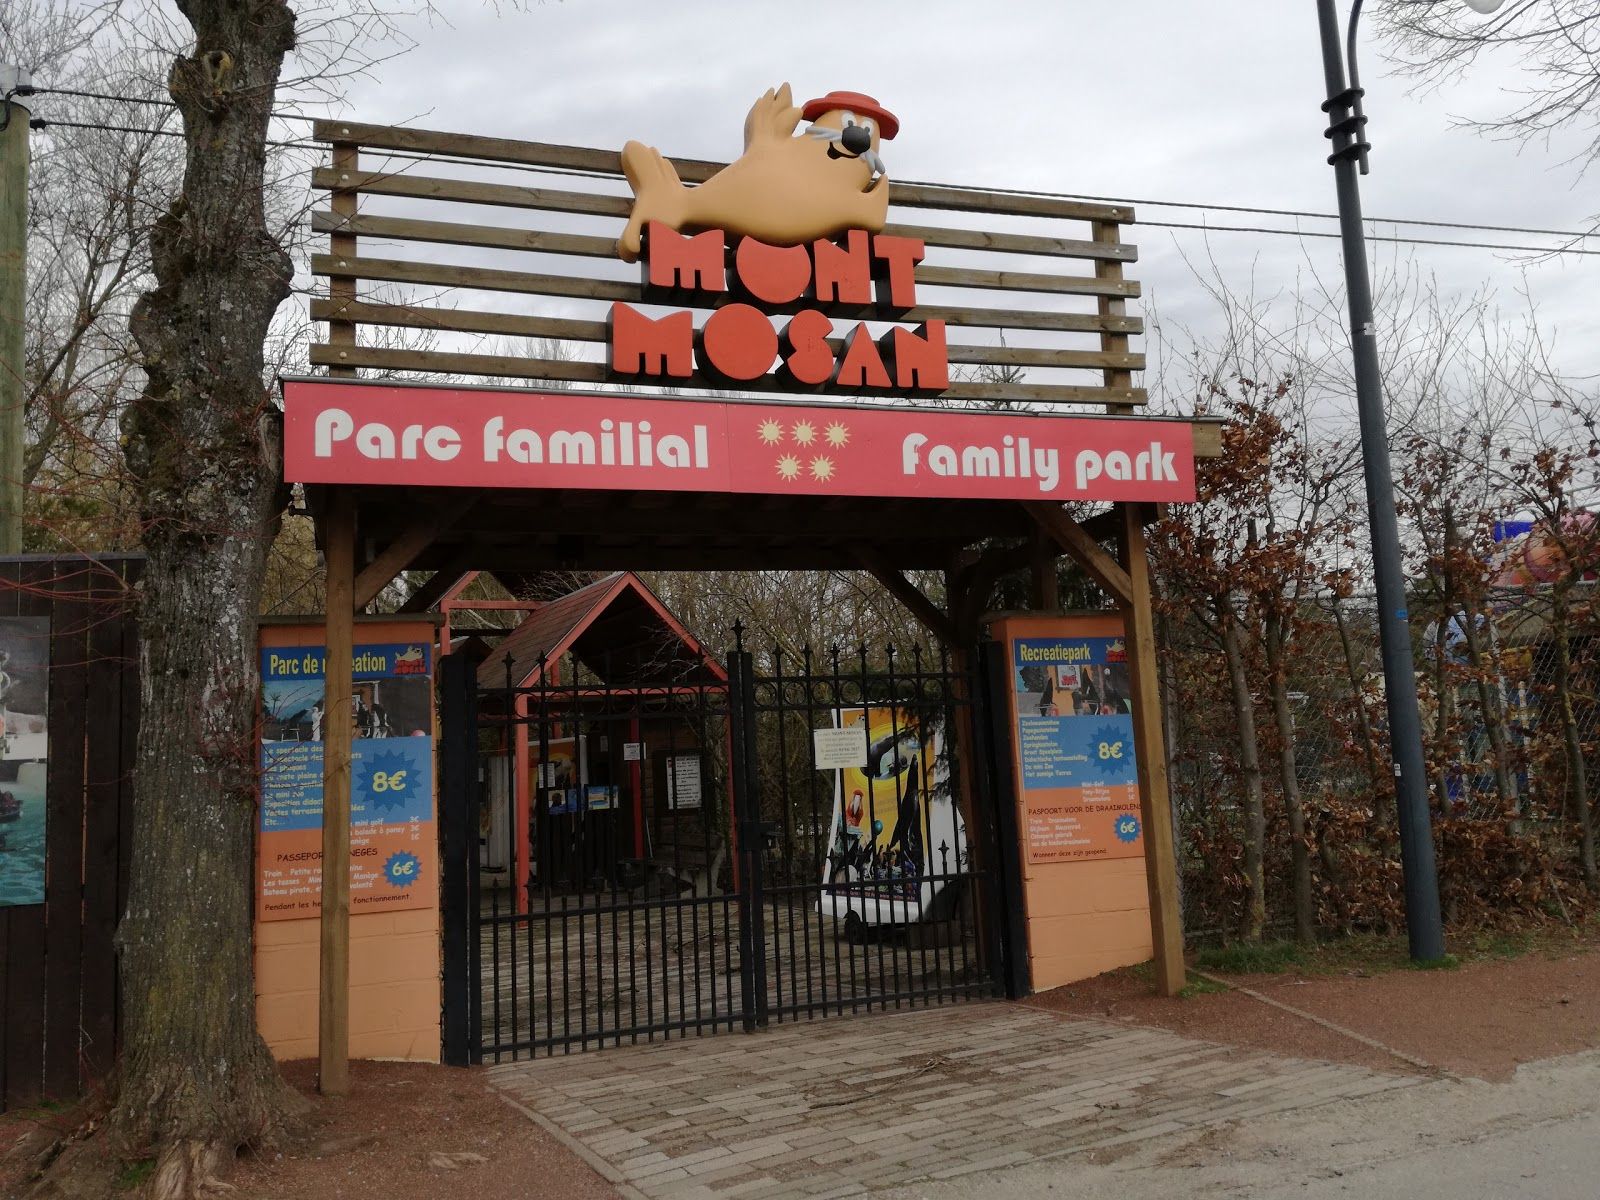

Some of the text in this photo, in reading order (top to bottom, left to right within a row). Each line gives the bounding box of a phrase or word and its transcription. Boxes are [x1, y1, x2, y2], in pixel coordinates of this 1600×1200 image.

[649, 220, 925, 309] MONT
[612, 301, 950, 391] MOSAN
[314, 408, 709, 469] Parc familial
[1075, 441, 1179, 490] park
[1020, 643, 1091, 664] Recreatiepark
[270, 654, 299, 675] Parc
[303, 653, 319, 674] de
[1098, 742, 1122, 759] 8€
[373, 770, 407, 792] 8€
[265, 809, 289, 817] Vastes
[1028, 807, 1062, 815] PASPOORT
[1064, 805, 1082, 814] VOOR
[1085, 805, 1094, 813] DE
[371, 818, 384, 827] golf
[1120, 822, 1135, 833] 6€
[386, 827, 405, 836] poney
[350, 837, 369, 846] anège
[277, 852, 324, 863] PASSEPOR
[1073, 849, 1084, 858] zijn
[263, 869, 282, 878] Train
[290, 867, 311, 876] Petite
[392, 861, 414, 876] 6€
[263, 879, 276, 887] Les
[353, 872, 378, 881] Manège
[263, 886, 288, 896] Bateau
[264, 902, 295, 911] Pendant
[298, 900, 310, 909] les
[353, 893, 409, 904] fonctionnement
